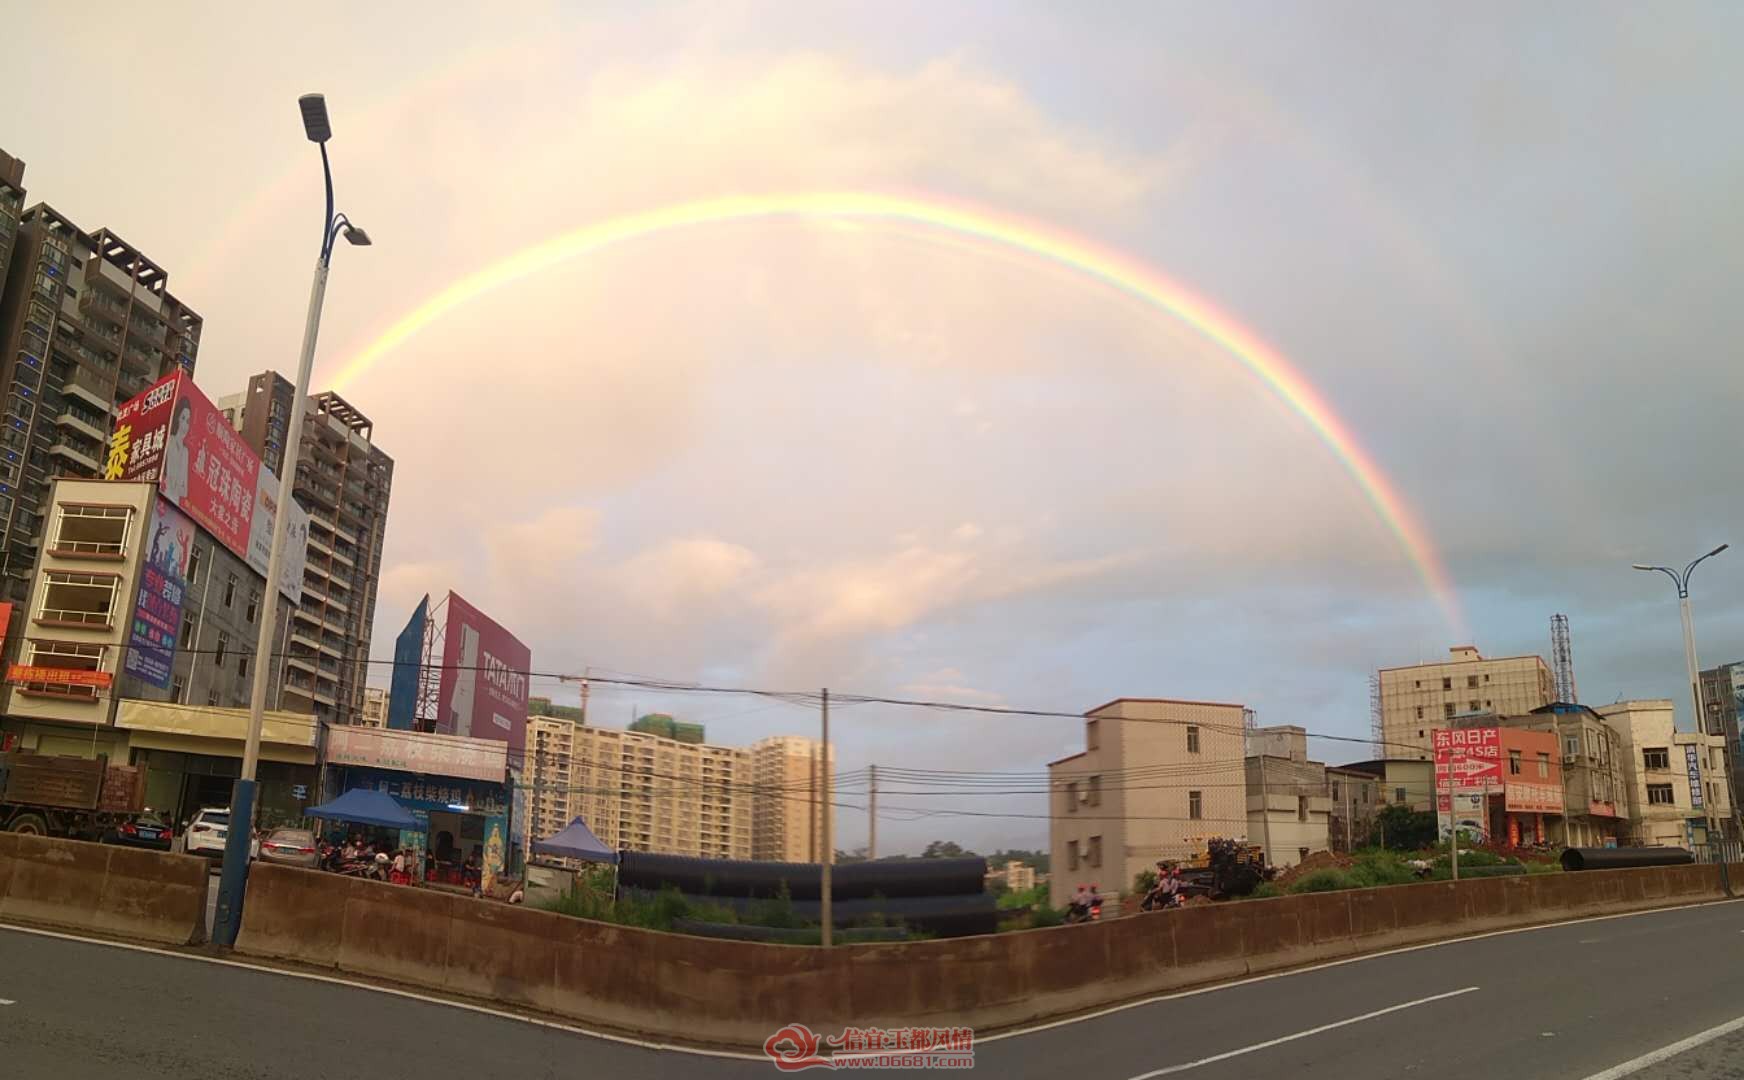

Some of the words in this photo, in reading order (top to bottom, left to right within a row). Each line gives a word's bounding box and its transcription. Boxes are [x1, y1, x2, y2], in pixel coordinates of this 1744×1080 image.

[206, 453, 252, 522] 冠珠陶瓷
[1437, 729, 1497, 747] 东风日产
